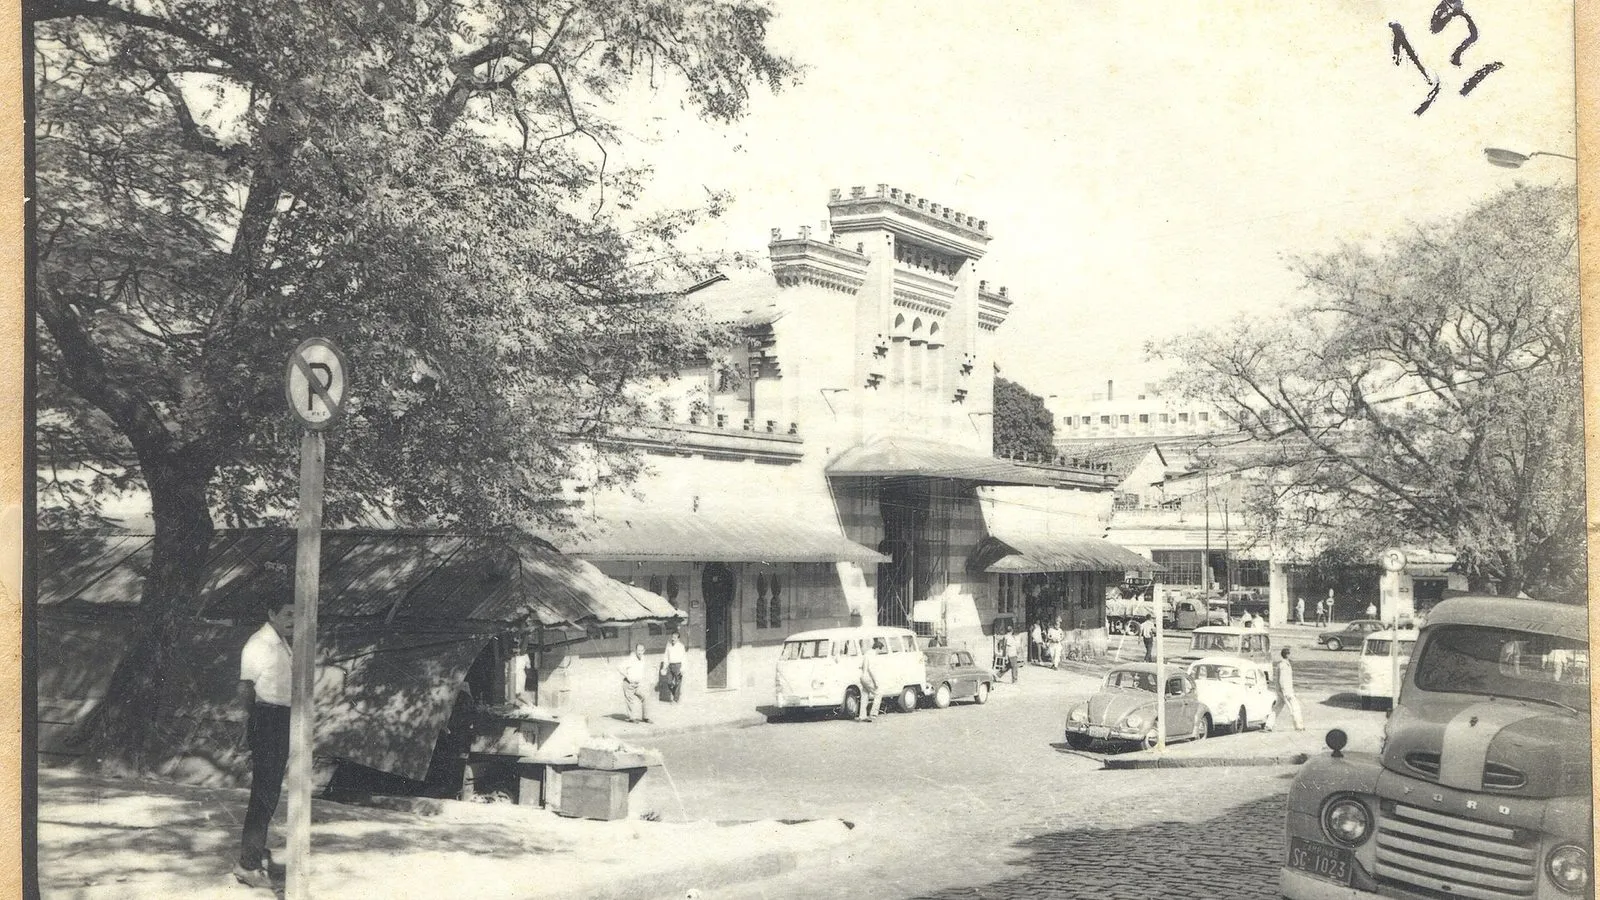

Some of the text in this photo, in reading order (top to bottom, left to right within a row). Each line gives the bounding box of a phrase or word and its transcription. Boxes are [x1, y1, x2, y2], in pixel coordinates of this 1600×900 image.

[308, 362, 332, 410] P
[1404, 786, 1510, 815] FORD
[1315, 855, 1346, 878] 1023
